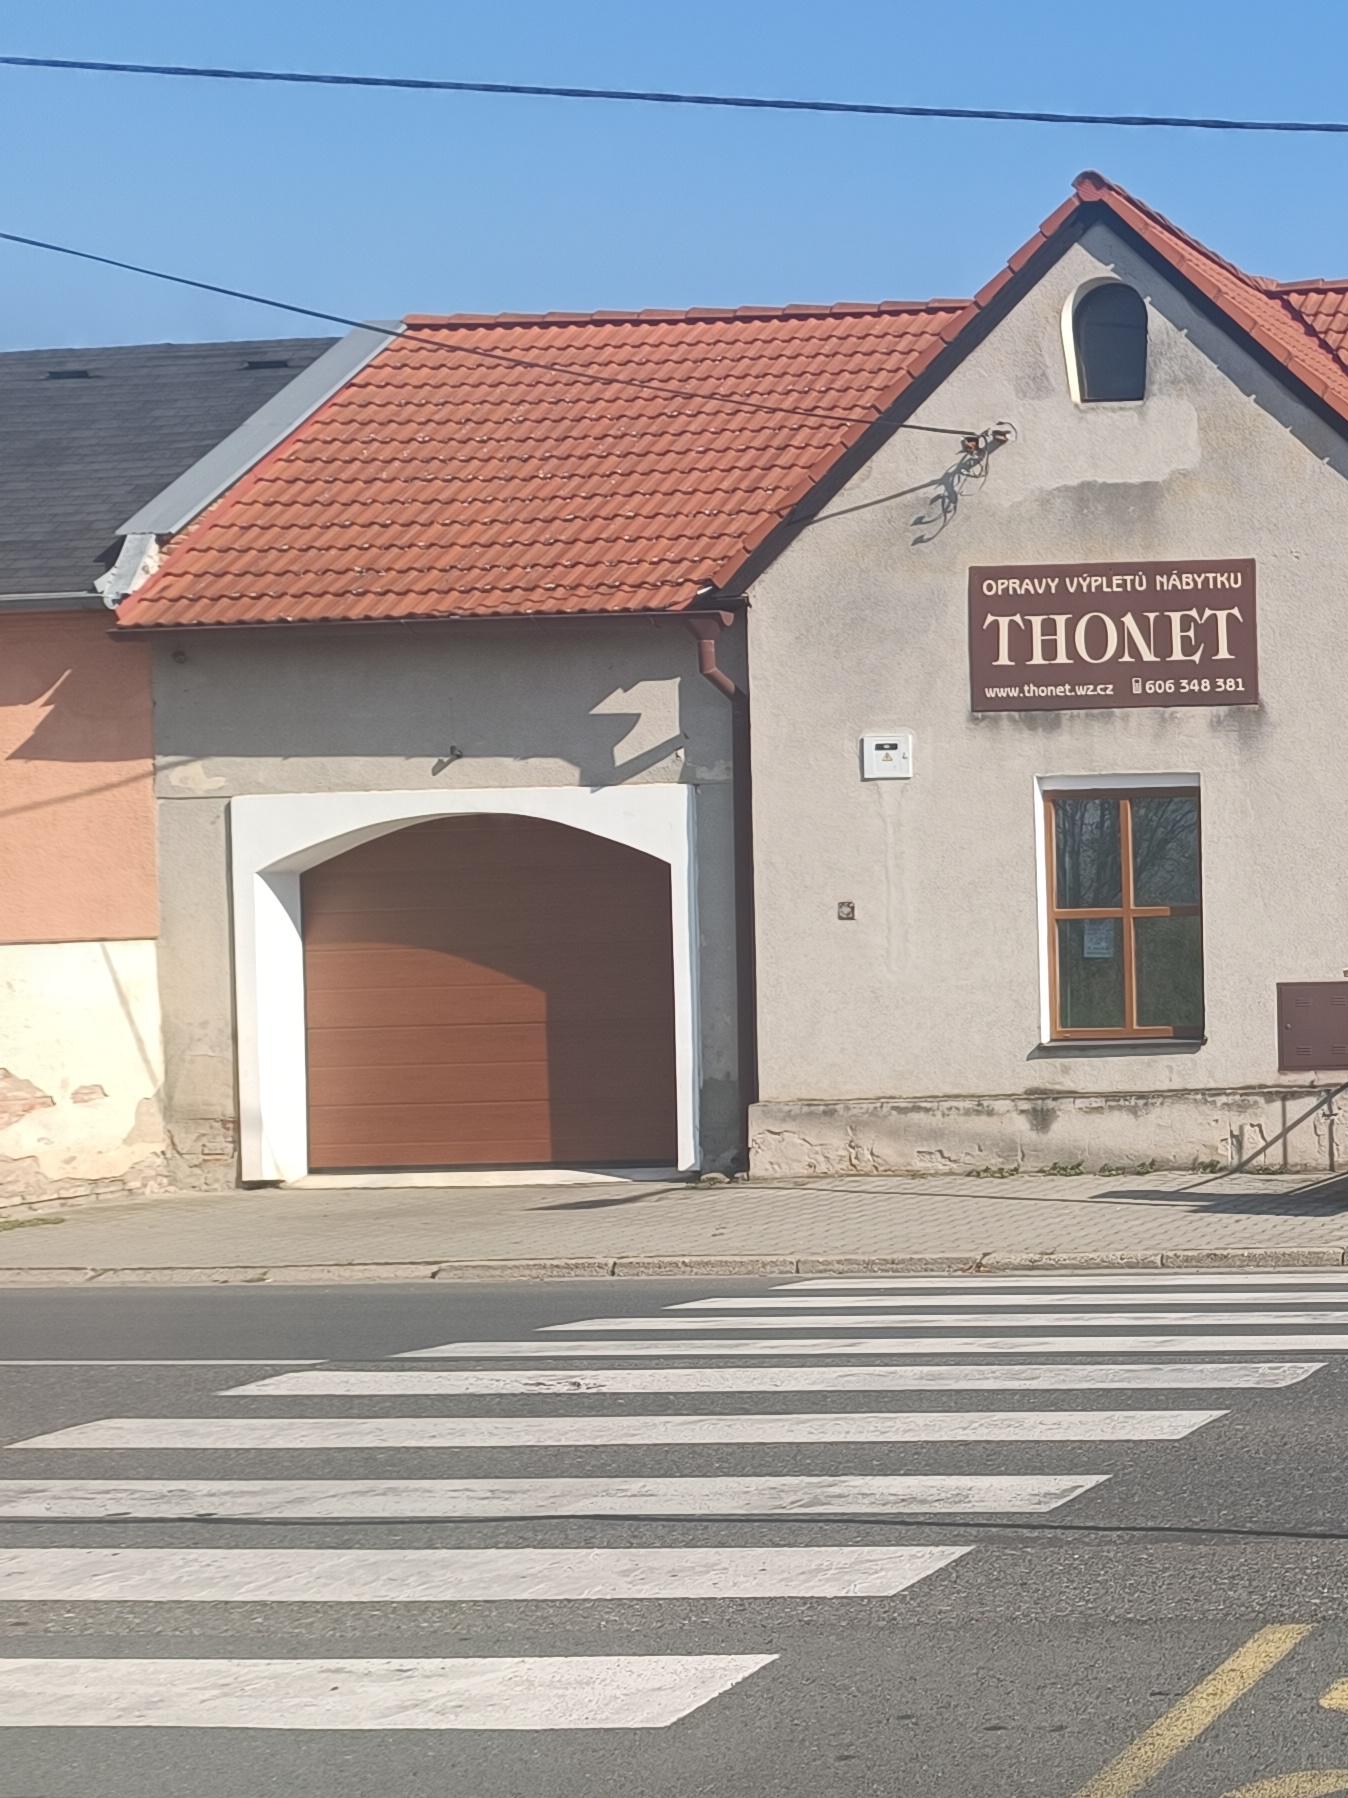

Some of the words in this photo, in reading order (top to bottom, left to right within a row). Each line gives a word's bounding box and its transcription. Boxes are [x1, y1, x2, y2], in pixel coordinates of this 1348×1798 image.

[982, 577, 1059, 596] OPRAVY
[1065, 571, 1147, 594] VÝPLETŮ
[1155, 570, 1242, 591] NÁBYTKU
[982, 606, 1244, 666] THONET
[984, 683, 1114, 698] www.thonet.wz.cz
[1145, 679, 1175, 694] 606
[1179, 678, 1211, 693] 348
[1215, 677, 1245, 692] 381
